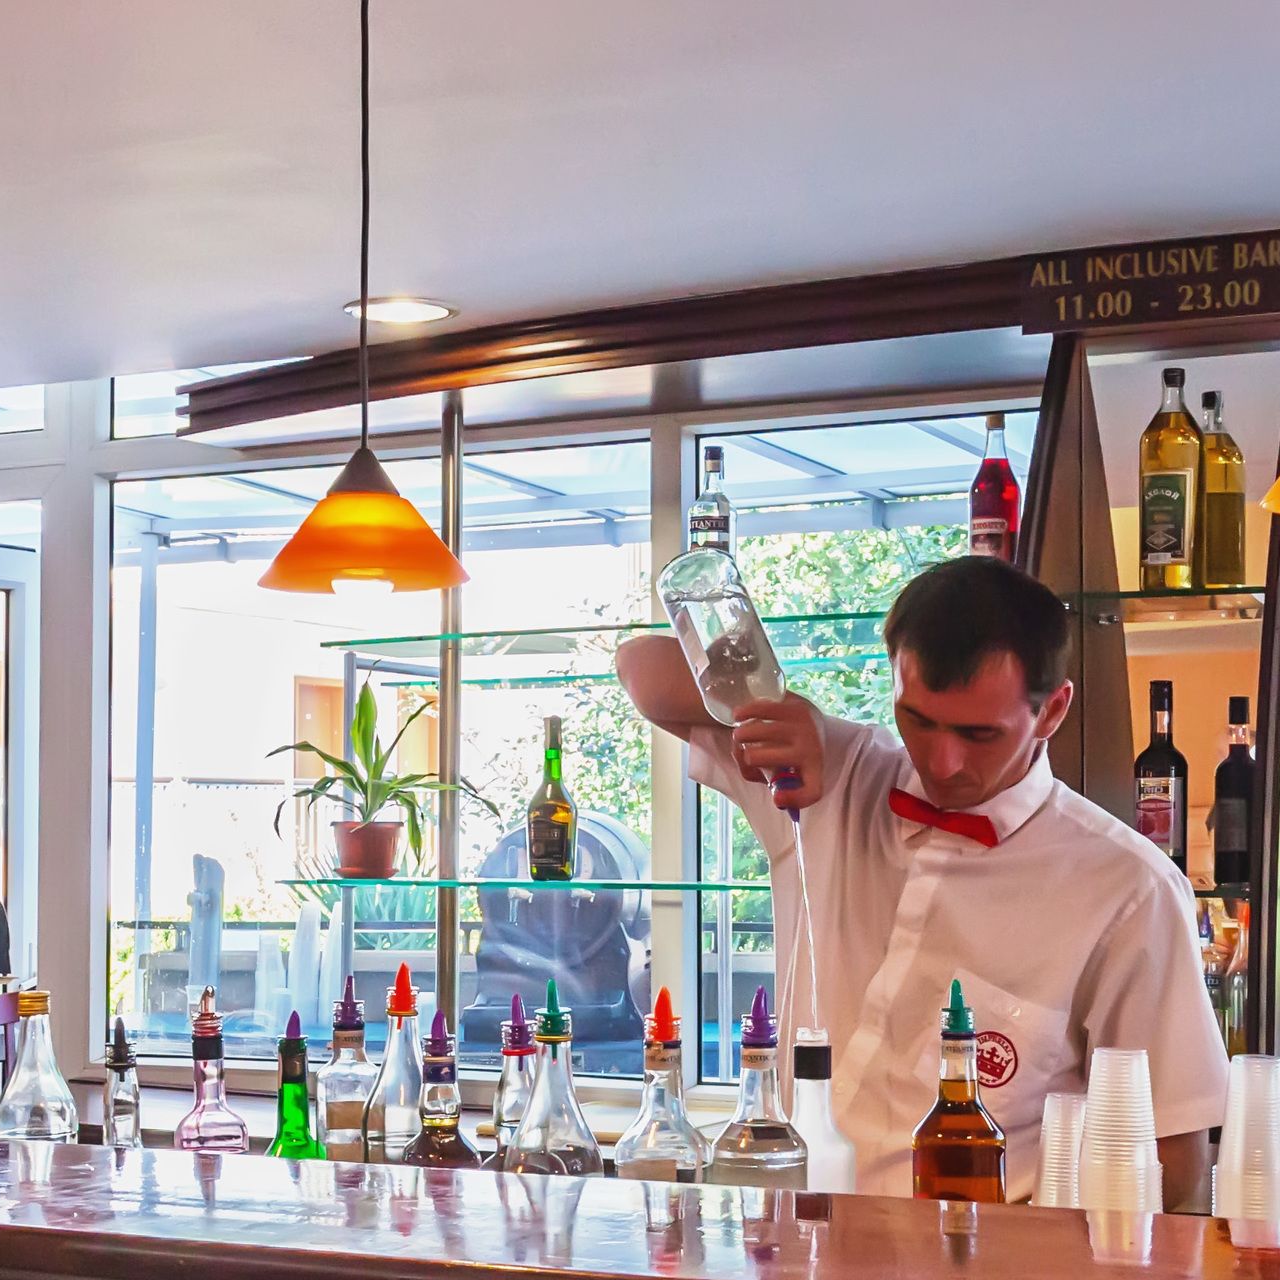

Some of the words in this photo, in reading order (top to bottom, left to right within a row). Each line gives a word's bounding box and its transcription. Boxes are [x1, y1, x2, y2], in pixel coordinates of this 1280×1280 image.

[1030, 259, 1073, 288] ALL
[1086, 245, 1219, 283] INCLUSIVE
[1055, 290, 1132, 321] 11.00
[1177, 279, 1261, 312] 23.00
